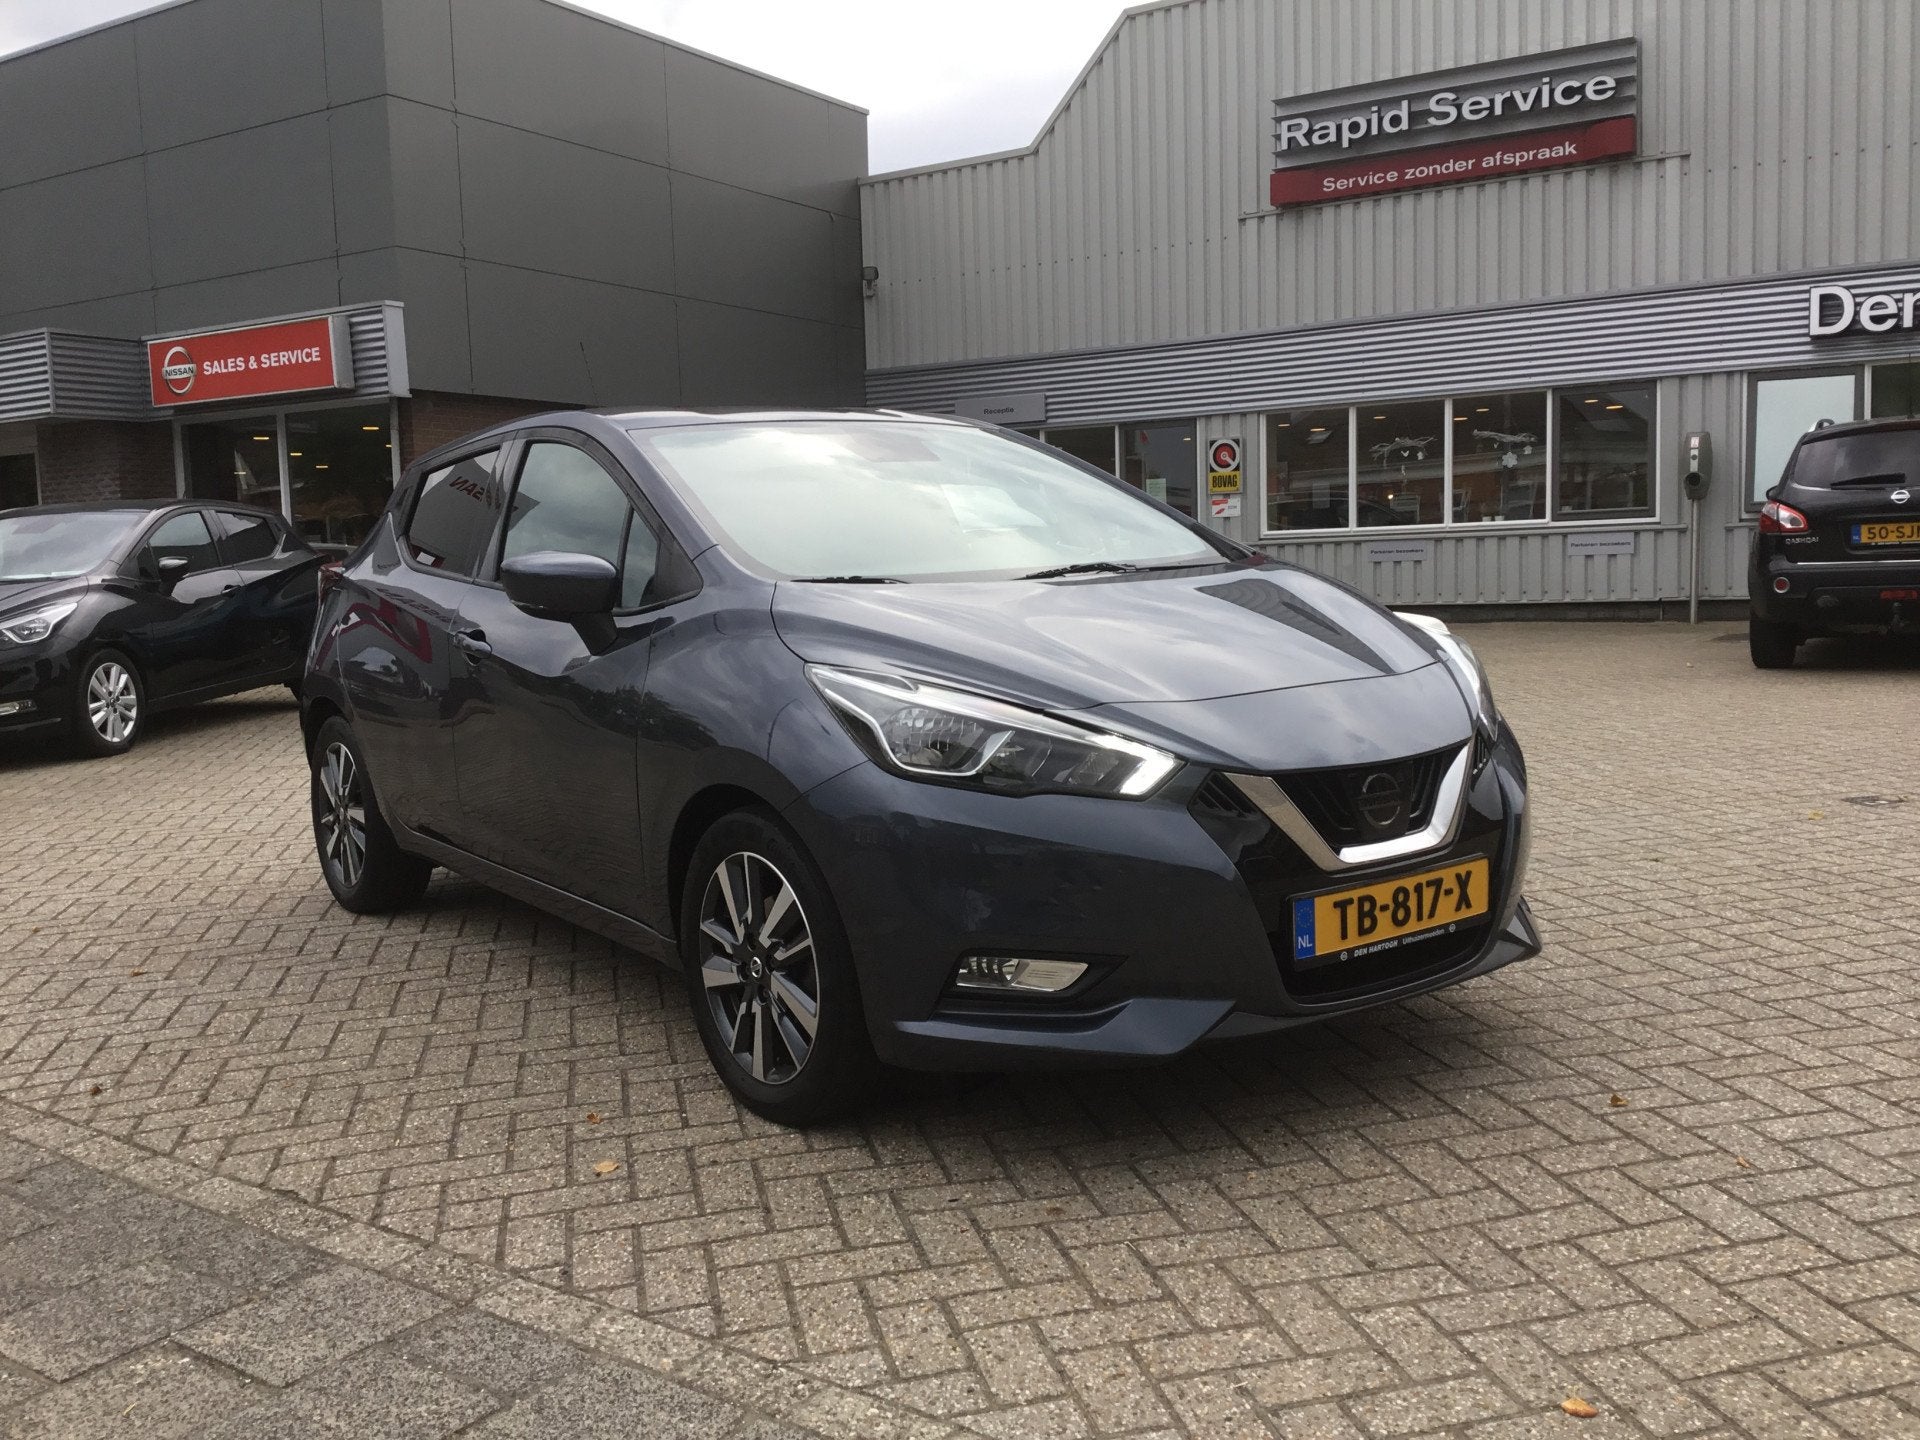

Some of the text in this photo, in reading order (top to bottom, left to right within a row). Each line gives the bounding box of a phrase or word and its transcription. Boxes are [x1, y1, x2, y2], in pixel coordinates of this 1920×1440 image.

[1280, 73, 1616, 149] Rapid Service
[1322, 141, 1577, 191] Service zonder afspraak
[203, 347, 321, 375] SALES & SERVICE
[164, 366, 195, 377] NISSAN
[983, 407, 1014, 415] Receptie
[1212, 474, 1238, 488] BOVAG
[1867, 525, 1920, 540] 50-SJ
[1333, 869, 1473, 941] TB-817-X
[1298, 936, 1312, 950] NL
[1354, 947, 1368, 957] DEN
